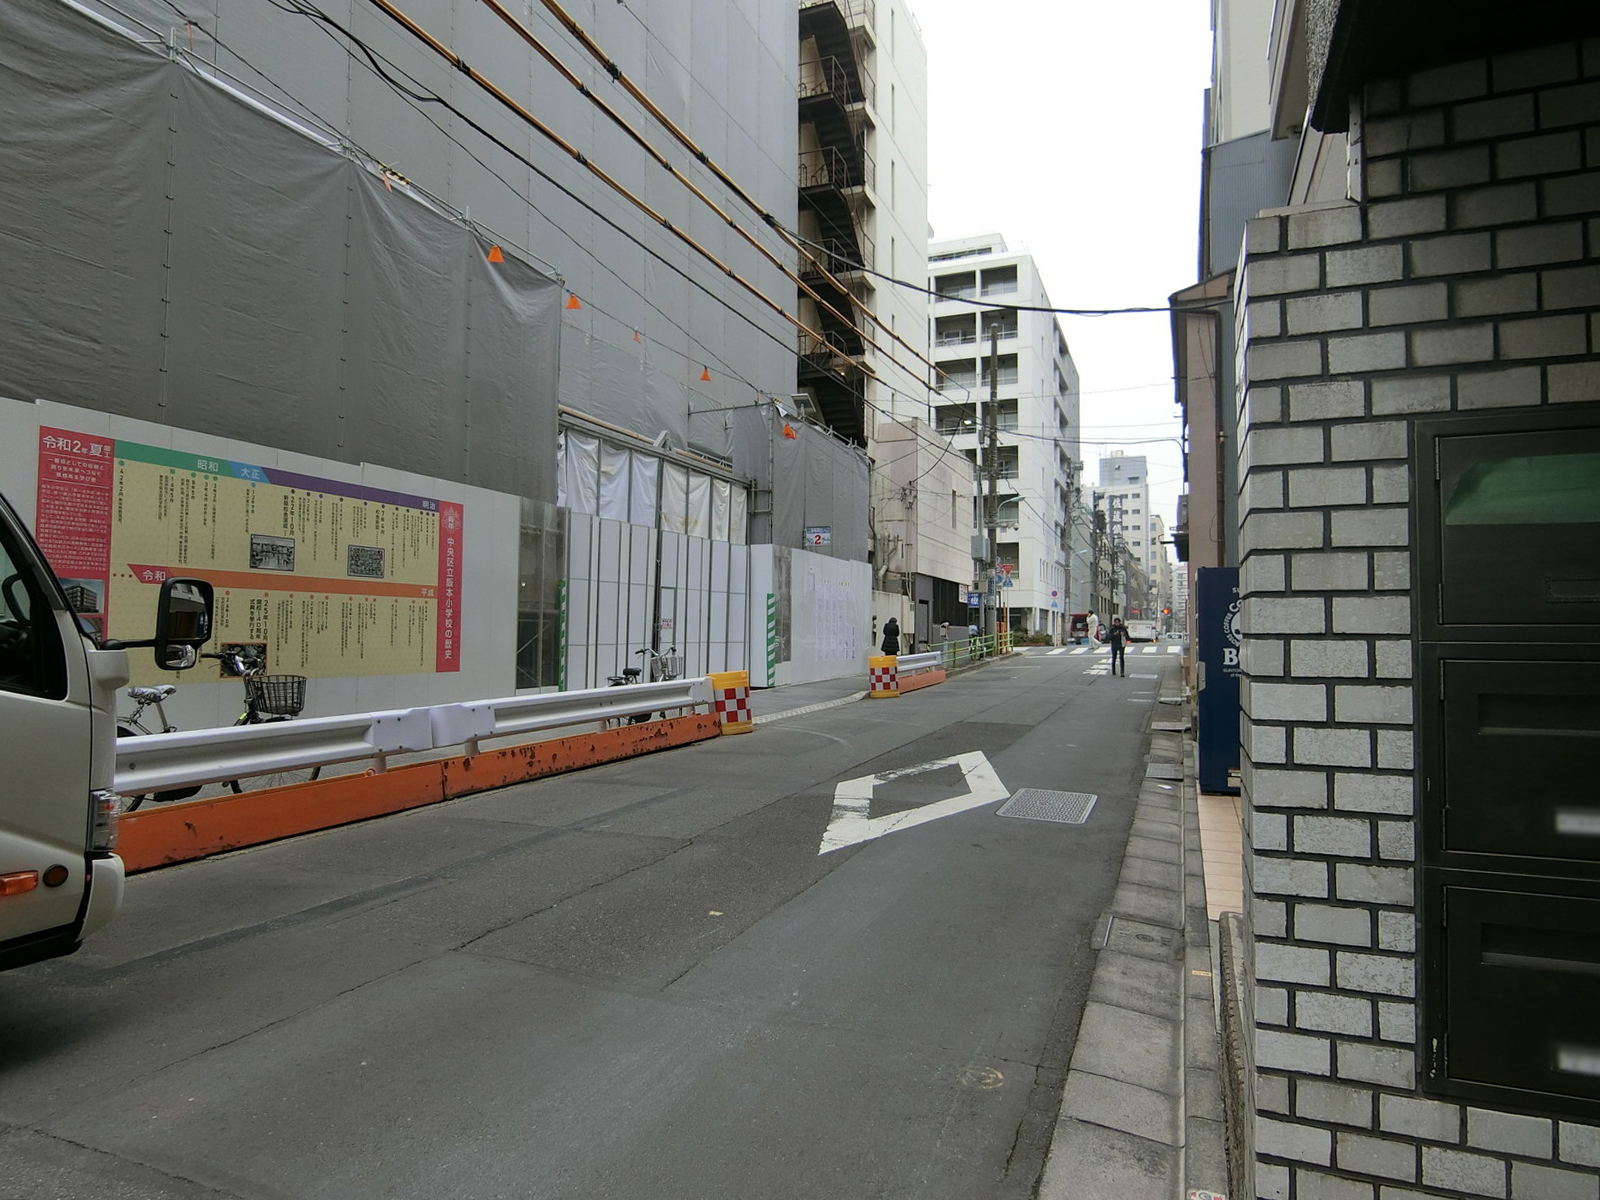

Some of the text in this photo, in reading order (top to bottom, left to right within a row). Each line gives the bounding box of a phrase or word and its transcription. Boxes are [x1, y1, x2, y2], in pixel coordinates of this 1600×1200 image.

[197, 459, 218, 472] 昭和
[240, 467, 260, 480] 大正
[422, 500, 436, 510] 明治
[142, 569, 166, 581] 令和
[421, 588, 434, 597] 平成
[444, 537, 455, 660] 中央区立阪本小学校の歴史
